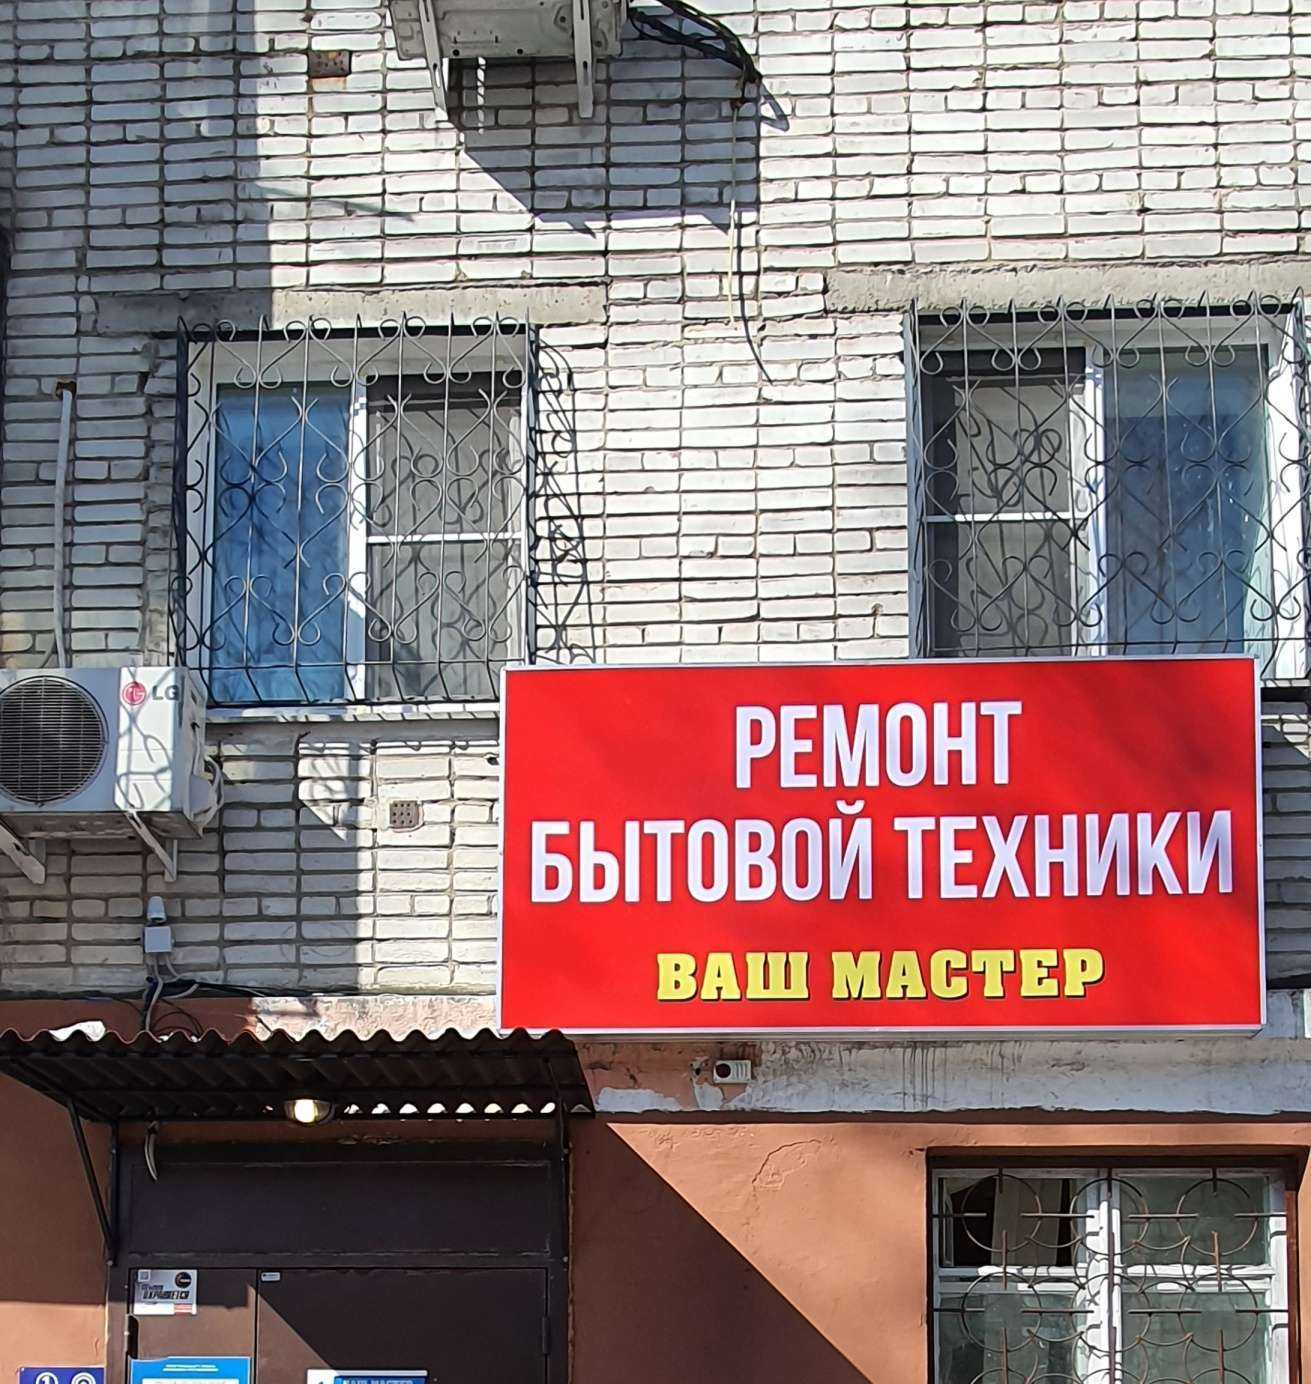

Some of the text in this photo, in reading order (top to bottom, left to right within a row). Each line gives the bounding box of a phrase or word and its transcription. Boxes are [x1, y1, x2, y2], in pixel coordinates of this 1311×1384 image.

[152, 685, 179, 701] LG
[735, 700, 1023, 789] РЕМОНТ
[530, 800, 1234, 903] БЫТОВОЙ ТЕХНИКИ
[656, 947, 1106, 1002] ВАШ МАСТЕР
